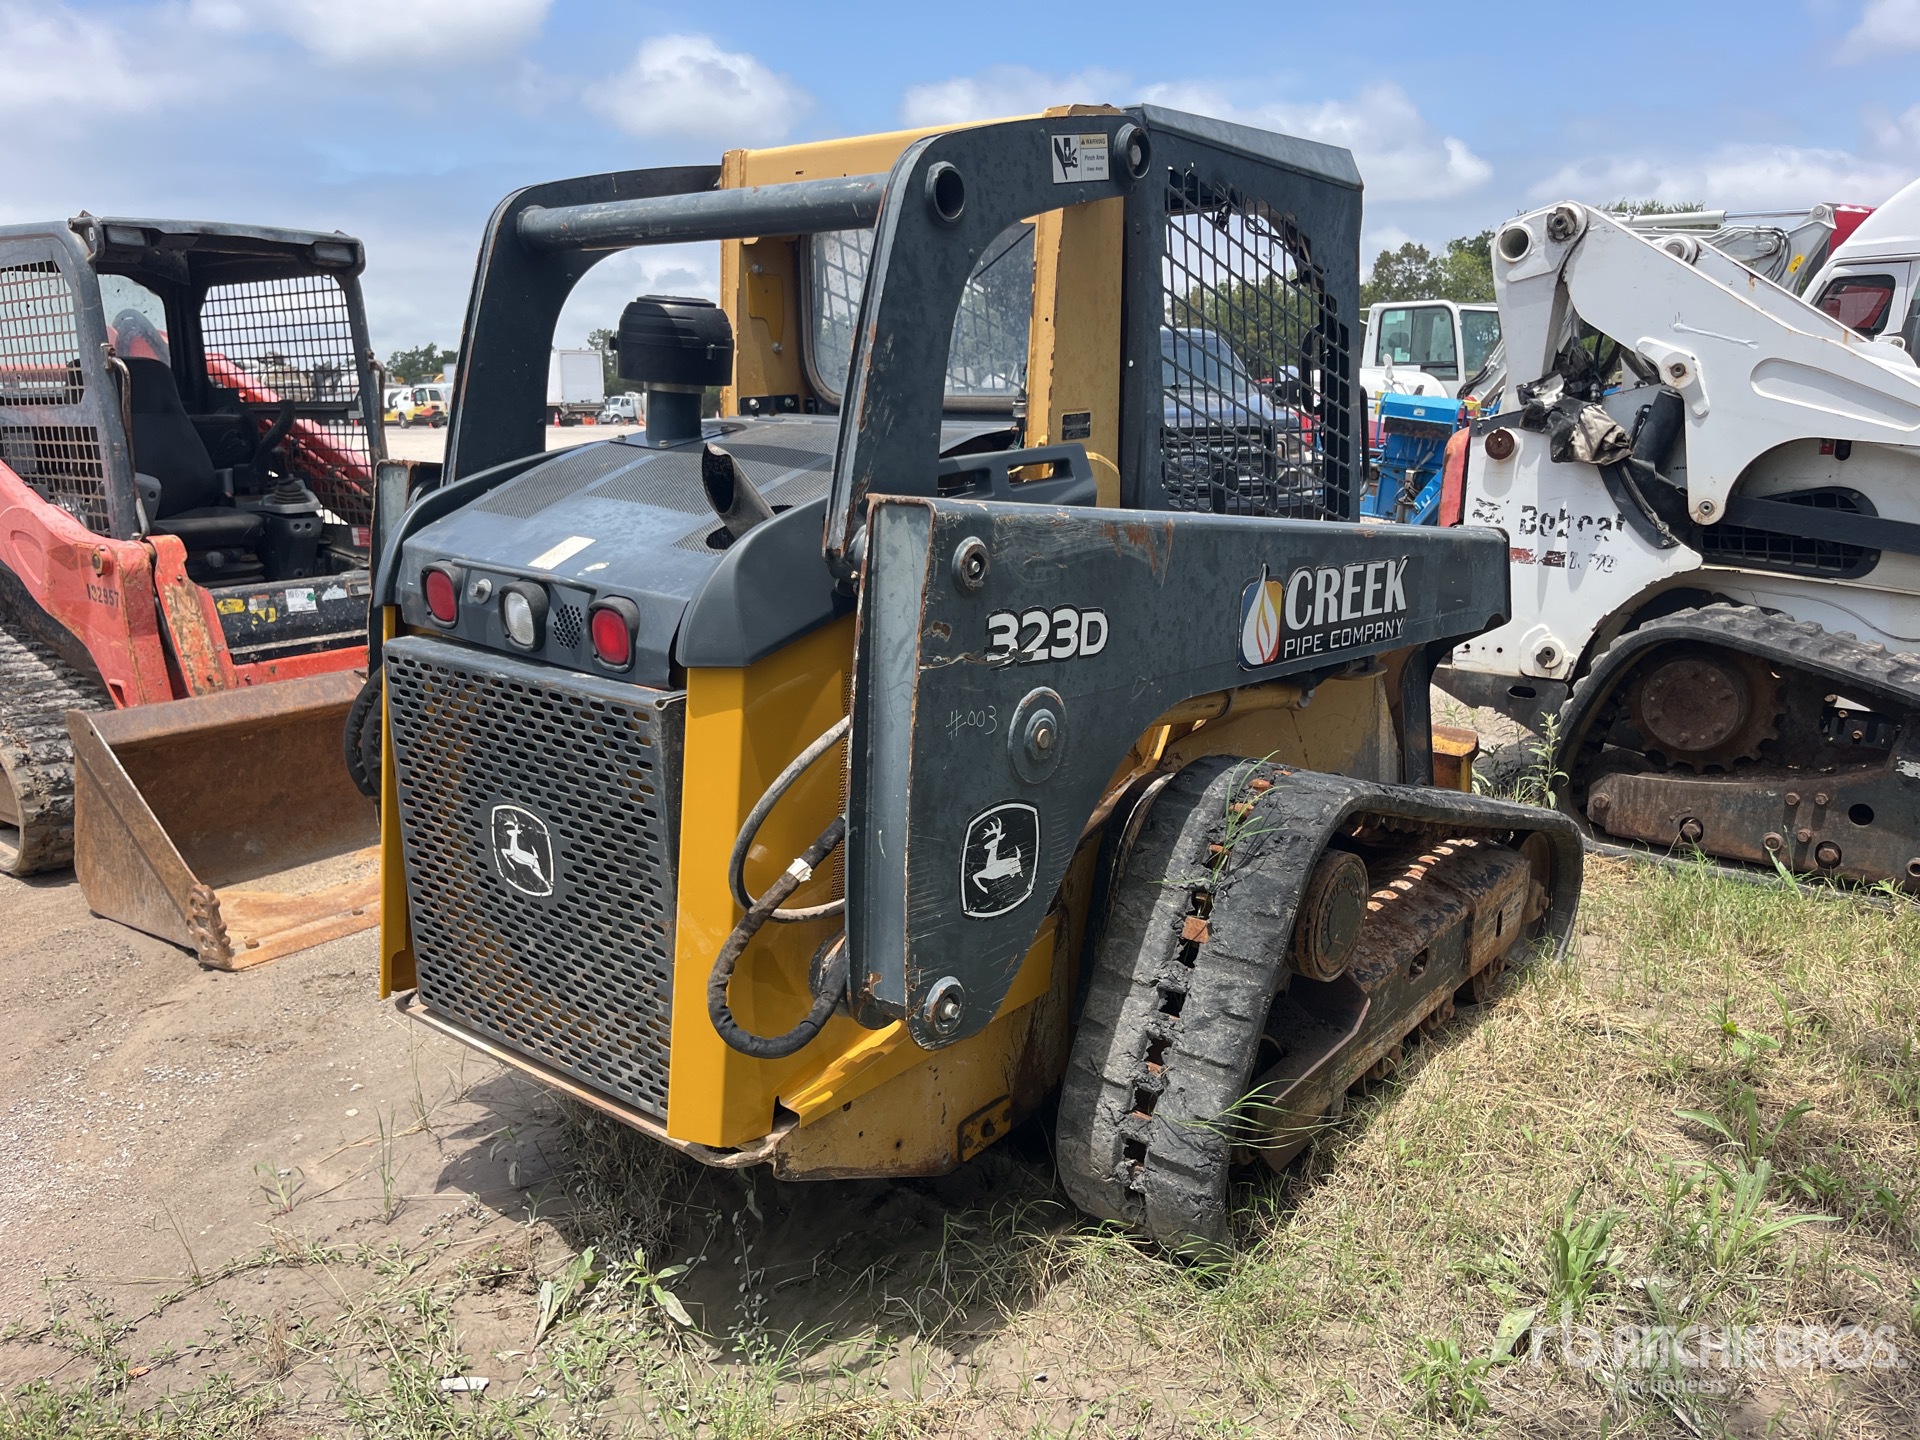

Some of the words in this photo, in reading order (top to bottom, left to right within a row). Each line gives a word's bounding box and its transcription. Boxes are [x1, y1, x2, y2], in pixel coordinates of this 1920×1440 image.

[1285, 559, 1408, 631] CREEK
[987, 608, 1108, 663] 323D
[1284, 633, 1323, 658] PIPE
[1330, 617, 1404, 649] COMPANY
[946, 705, 998, 737] #003
